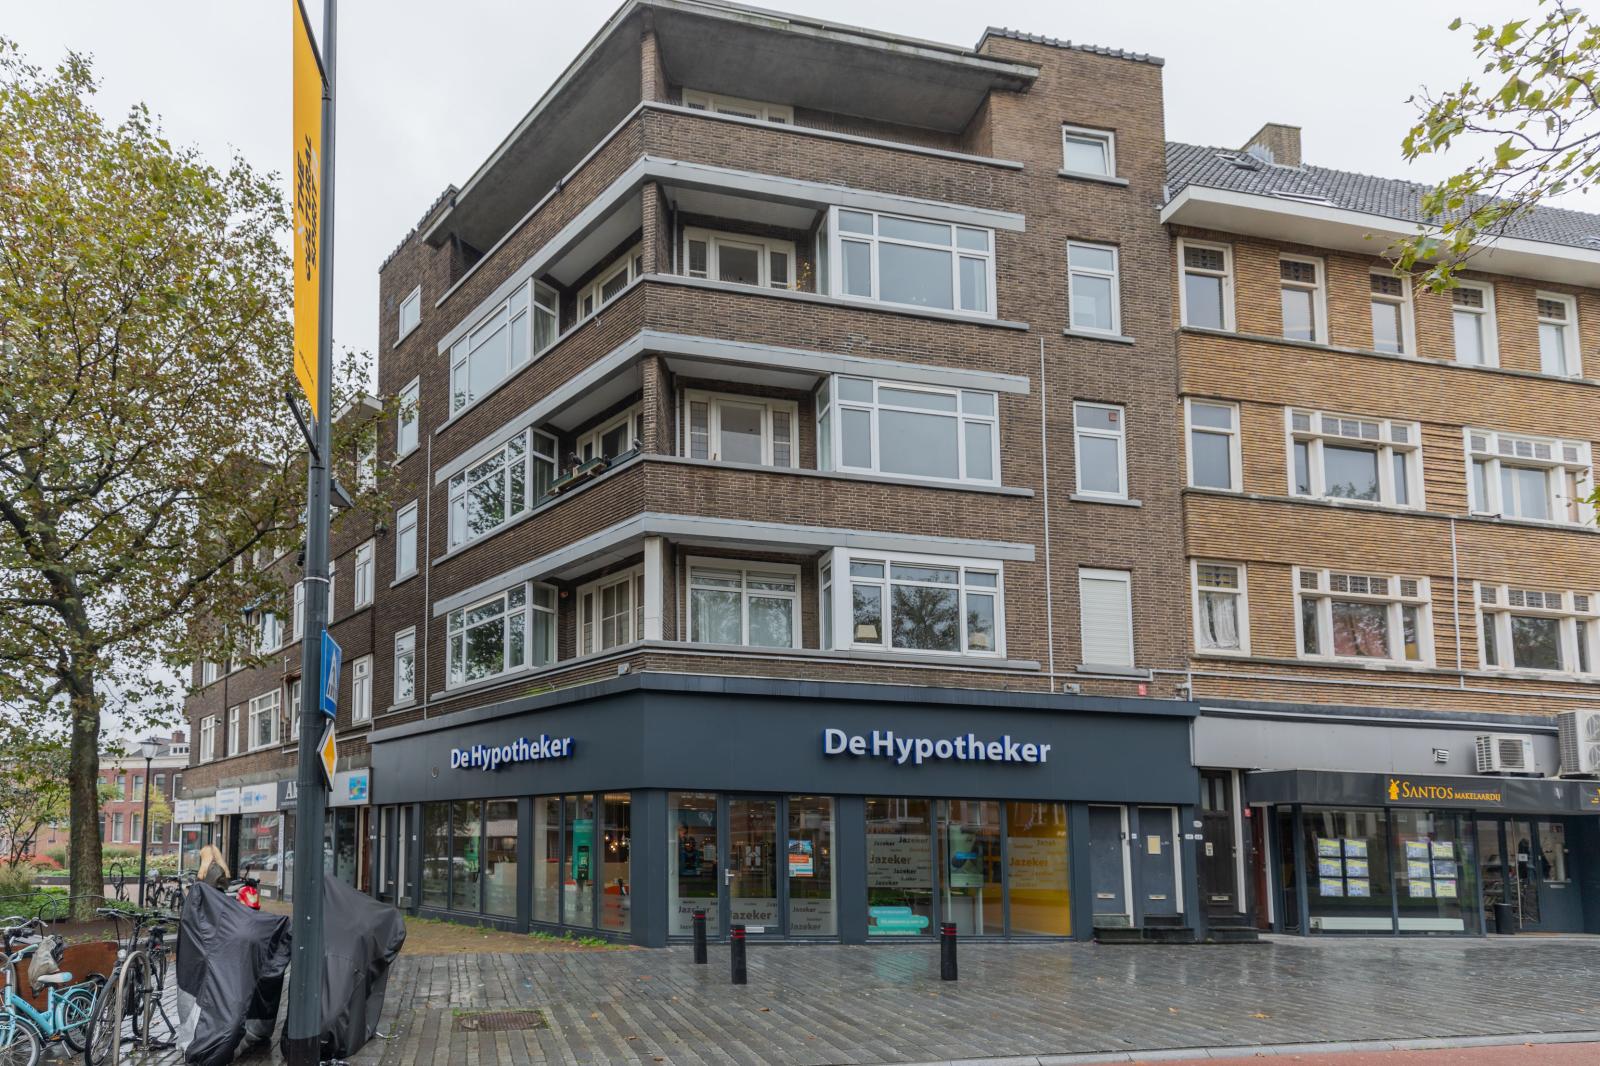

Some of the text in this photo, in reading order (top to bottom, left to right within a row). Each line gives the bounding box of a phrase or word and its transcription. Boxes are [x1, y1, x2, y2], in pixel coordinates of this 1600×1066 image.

[304, 132, 312, 283] CULTURAL
[450, 734, 573, 771] De Hypotheker
[824, 727, 1051, 764] De Hypotheker
[869, 853, 912, 865] Jazeker
[1009, 856, 1049, 867] Jazeker
[792, 904, 816, 913] Jazeker
